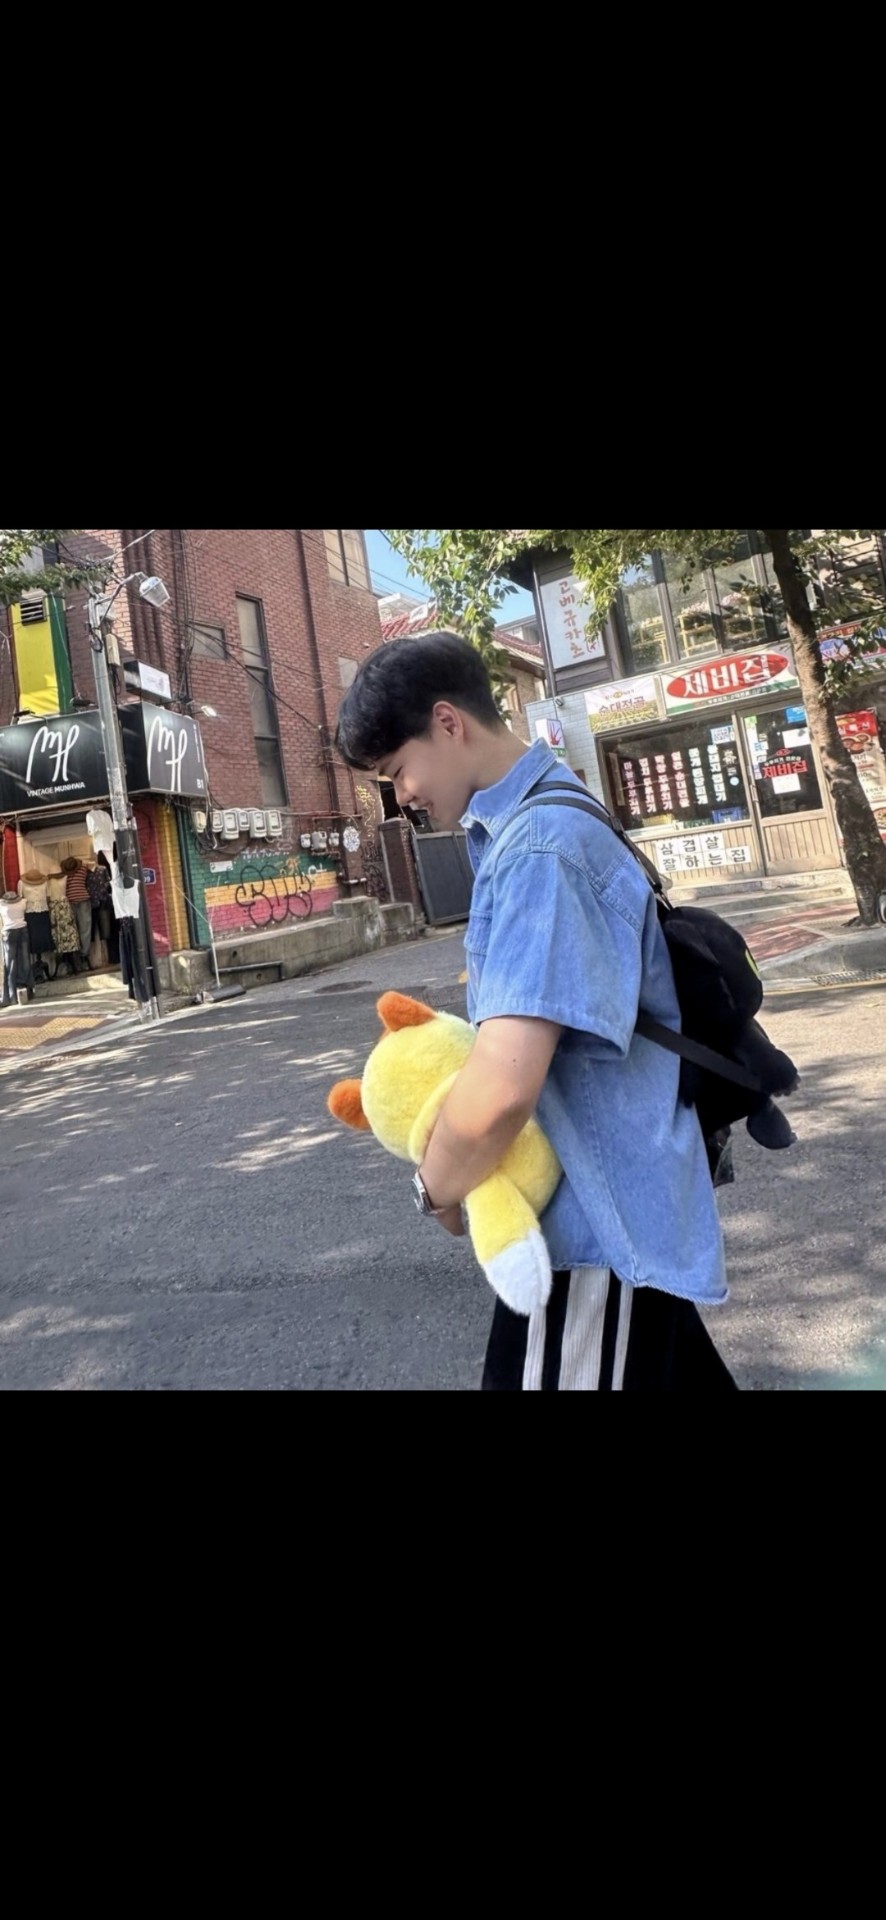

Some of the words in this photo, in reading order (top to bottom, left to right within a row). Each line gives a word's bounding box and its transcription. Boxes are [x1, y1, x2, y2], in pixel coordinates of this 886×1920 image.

[682, 654, 771, 697] 제비집
[762, 760, 808, 779] 제비집
[27, 786, 54, 798] VINTAGE
[660, 835, 720, 856] 삼겹살
